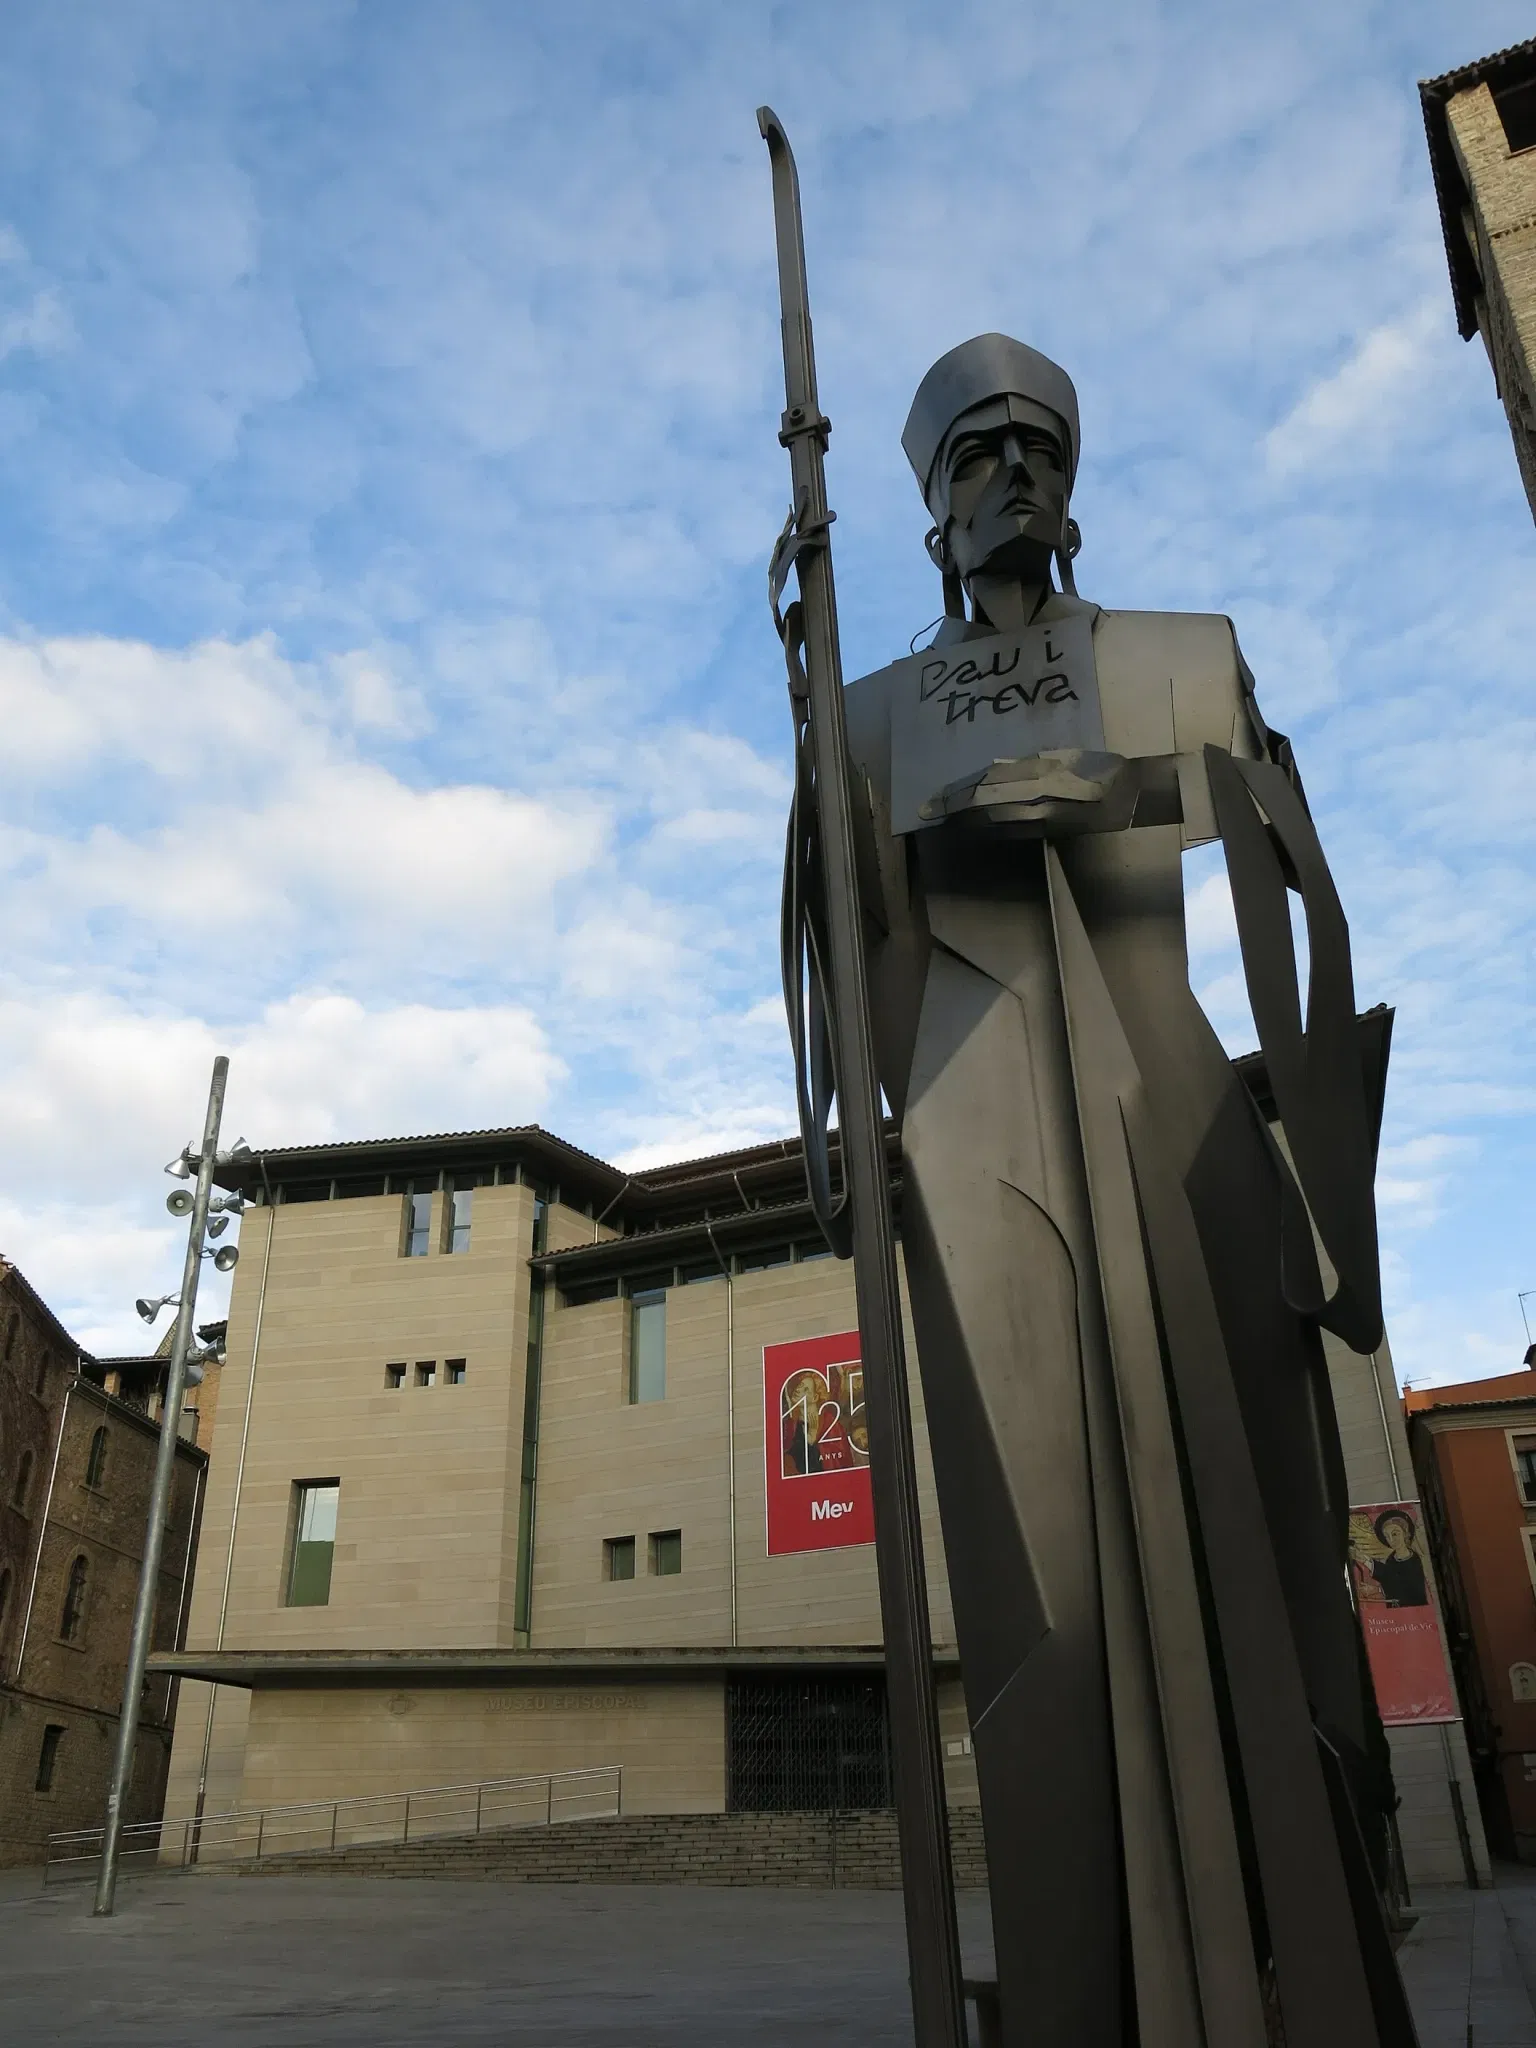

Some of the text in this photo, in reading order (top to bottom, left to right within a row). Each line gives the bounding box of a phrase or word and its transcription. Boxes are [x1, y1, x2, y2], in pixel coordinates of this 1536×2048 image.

[818, 1451, 844, 1462] ANYS
[810, 1499, 854, 1521] Mev
[1369, 1623, 1407, 1635] Episcopal
[485, 1695, 645, 1711] MUSEU EPISCOPAL
